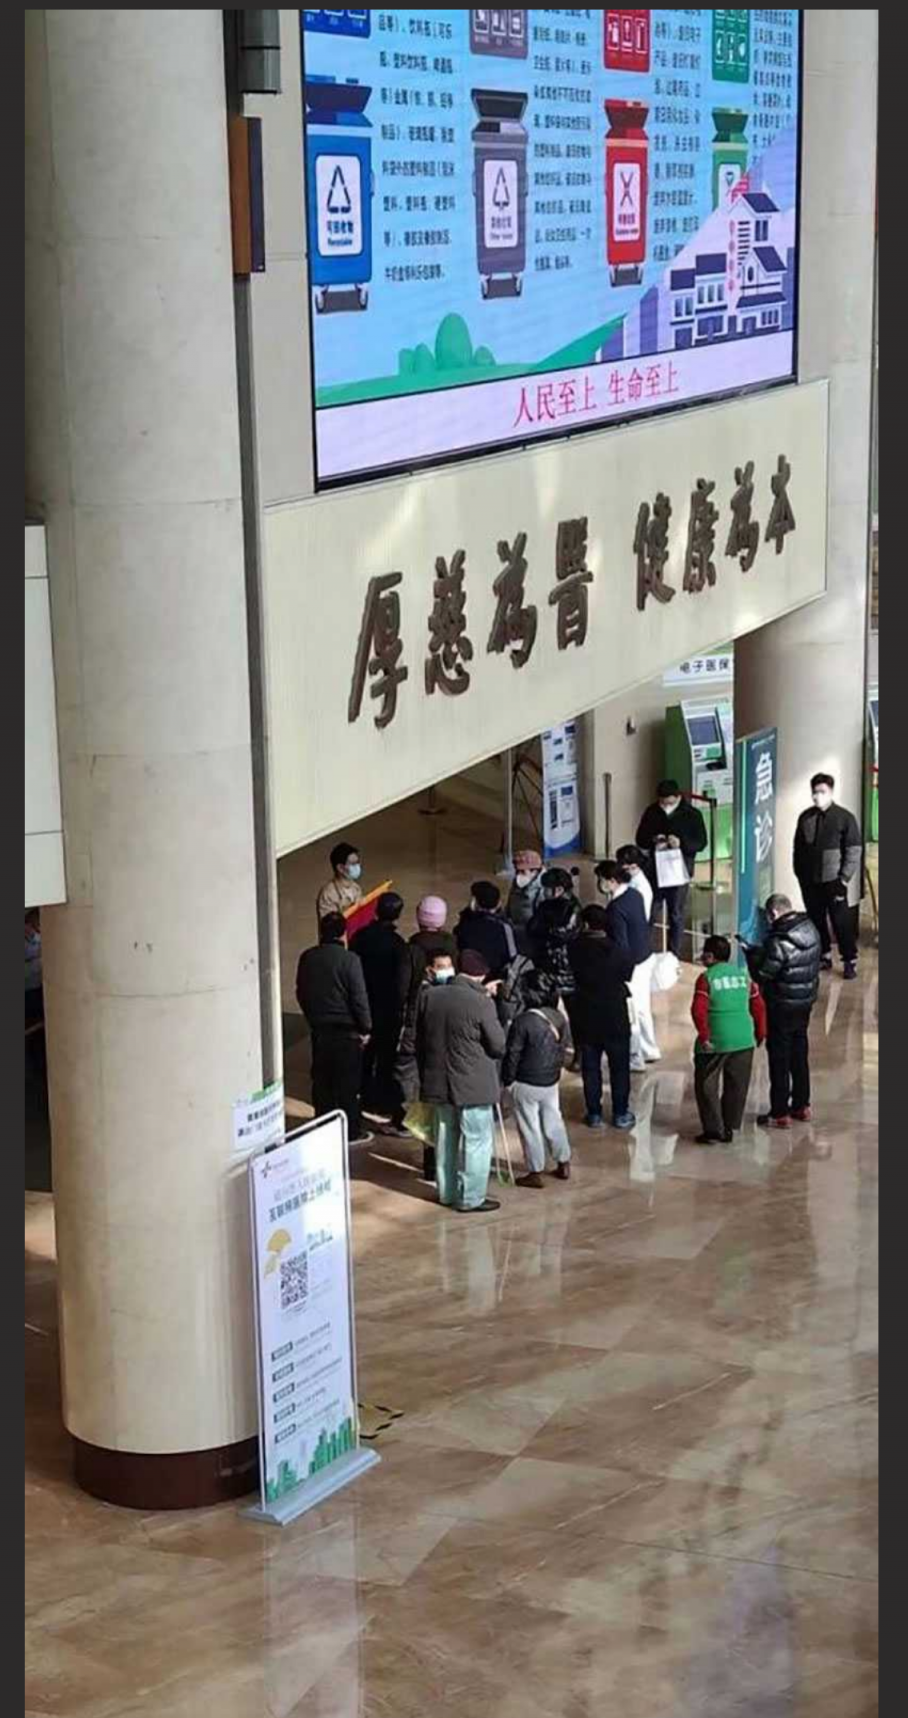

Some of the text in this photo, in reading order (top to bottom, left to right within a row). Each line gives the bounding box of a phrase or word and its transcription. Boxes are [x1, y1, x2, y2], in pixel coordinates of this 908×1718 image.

[513, 360, 680, 428] 人民至上 生命至上
[680, 658, 730, 674] 电子医保
[754, 752, 774, 864] 急诊
